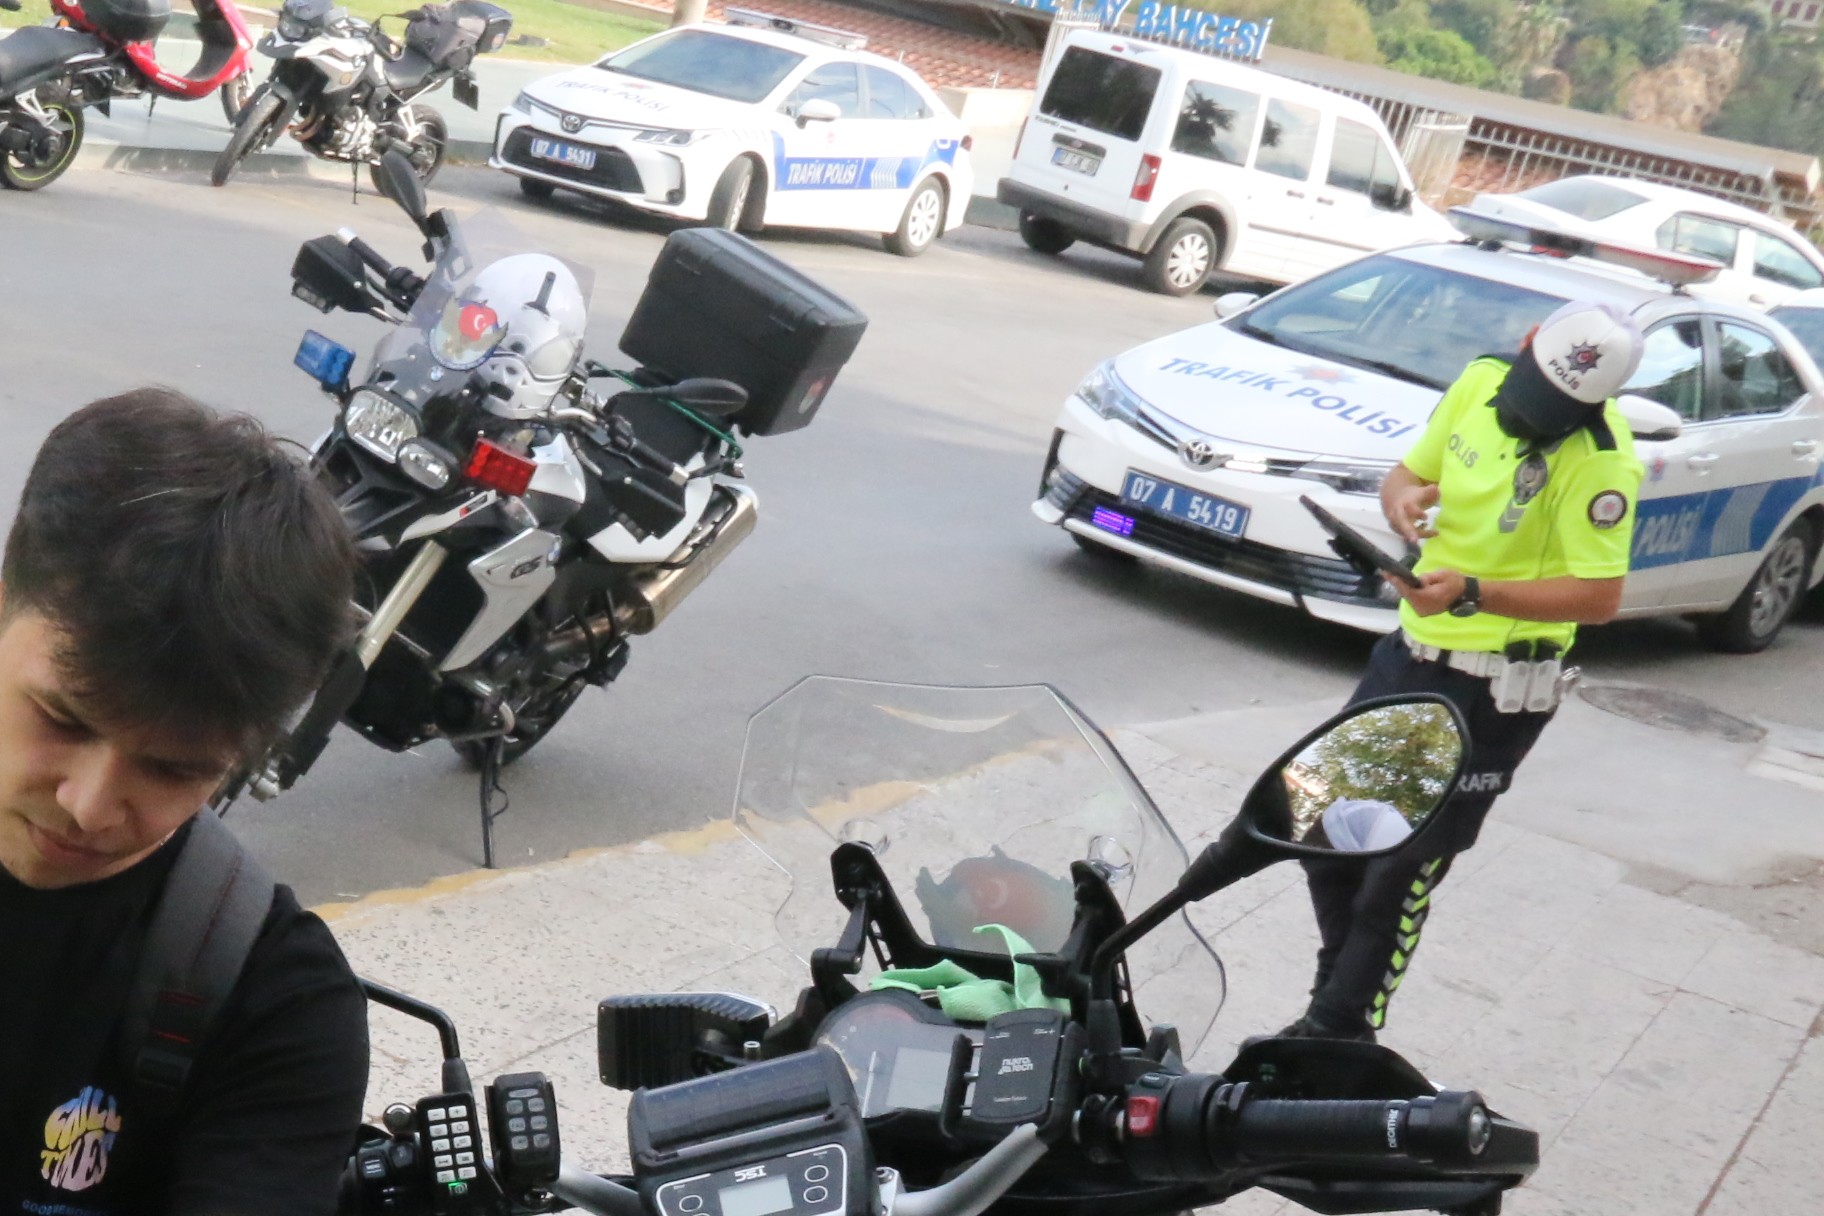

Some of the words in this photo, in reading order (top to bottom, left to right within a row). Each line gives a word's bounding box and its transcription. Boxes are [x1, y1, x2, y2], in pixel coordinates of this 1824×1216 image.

[787, 160, 825, 184] TRAFİK
[823, 160, 859, 184] POLİSİ
[1547, 358, 1580, 391] POLİS
[1159, 357, 1290, 391] TRAFİK
[1286, 385, 1418, 439] POLİSİ
[1129, 477, 1156, 503] 07
[1161, 488, 1174, 510] A
[1187, 497, 1238, 532] 5419
